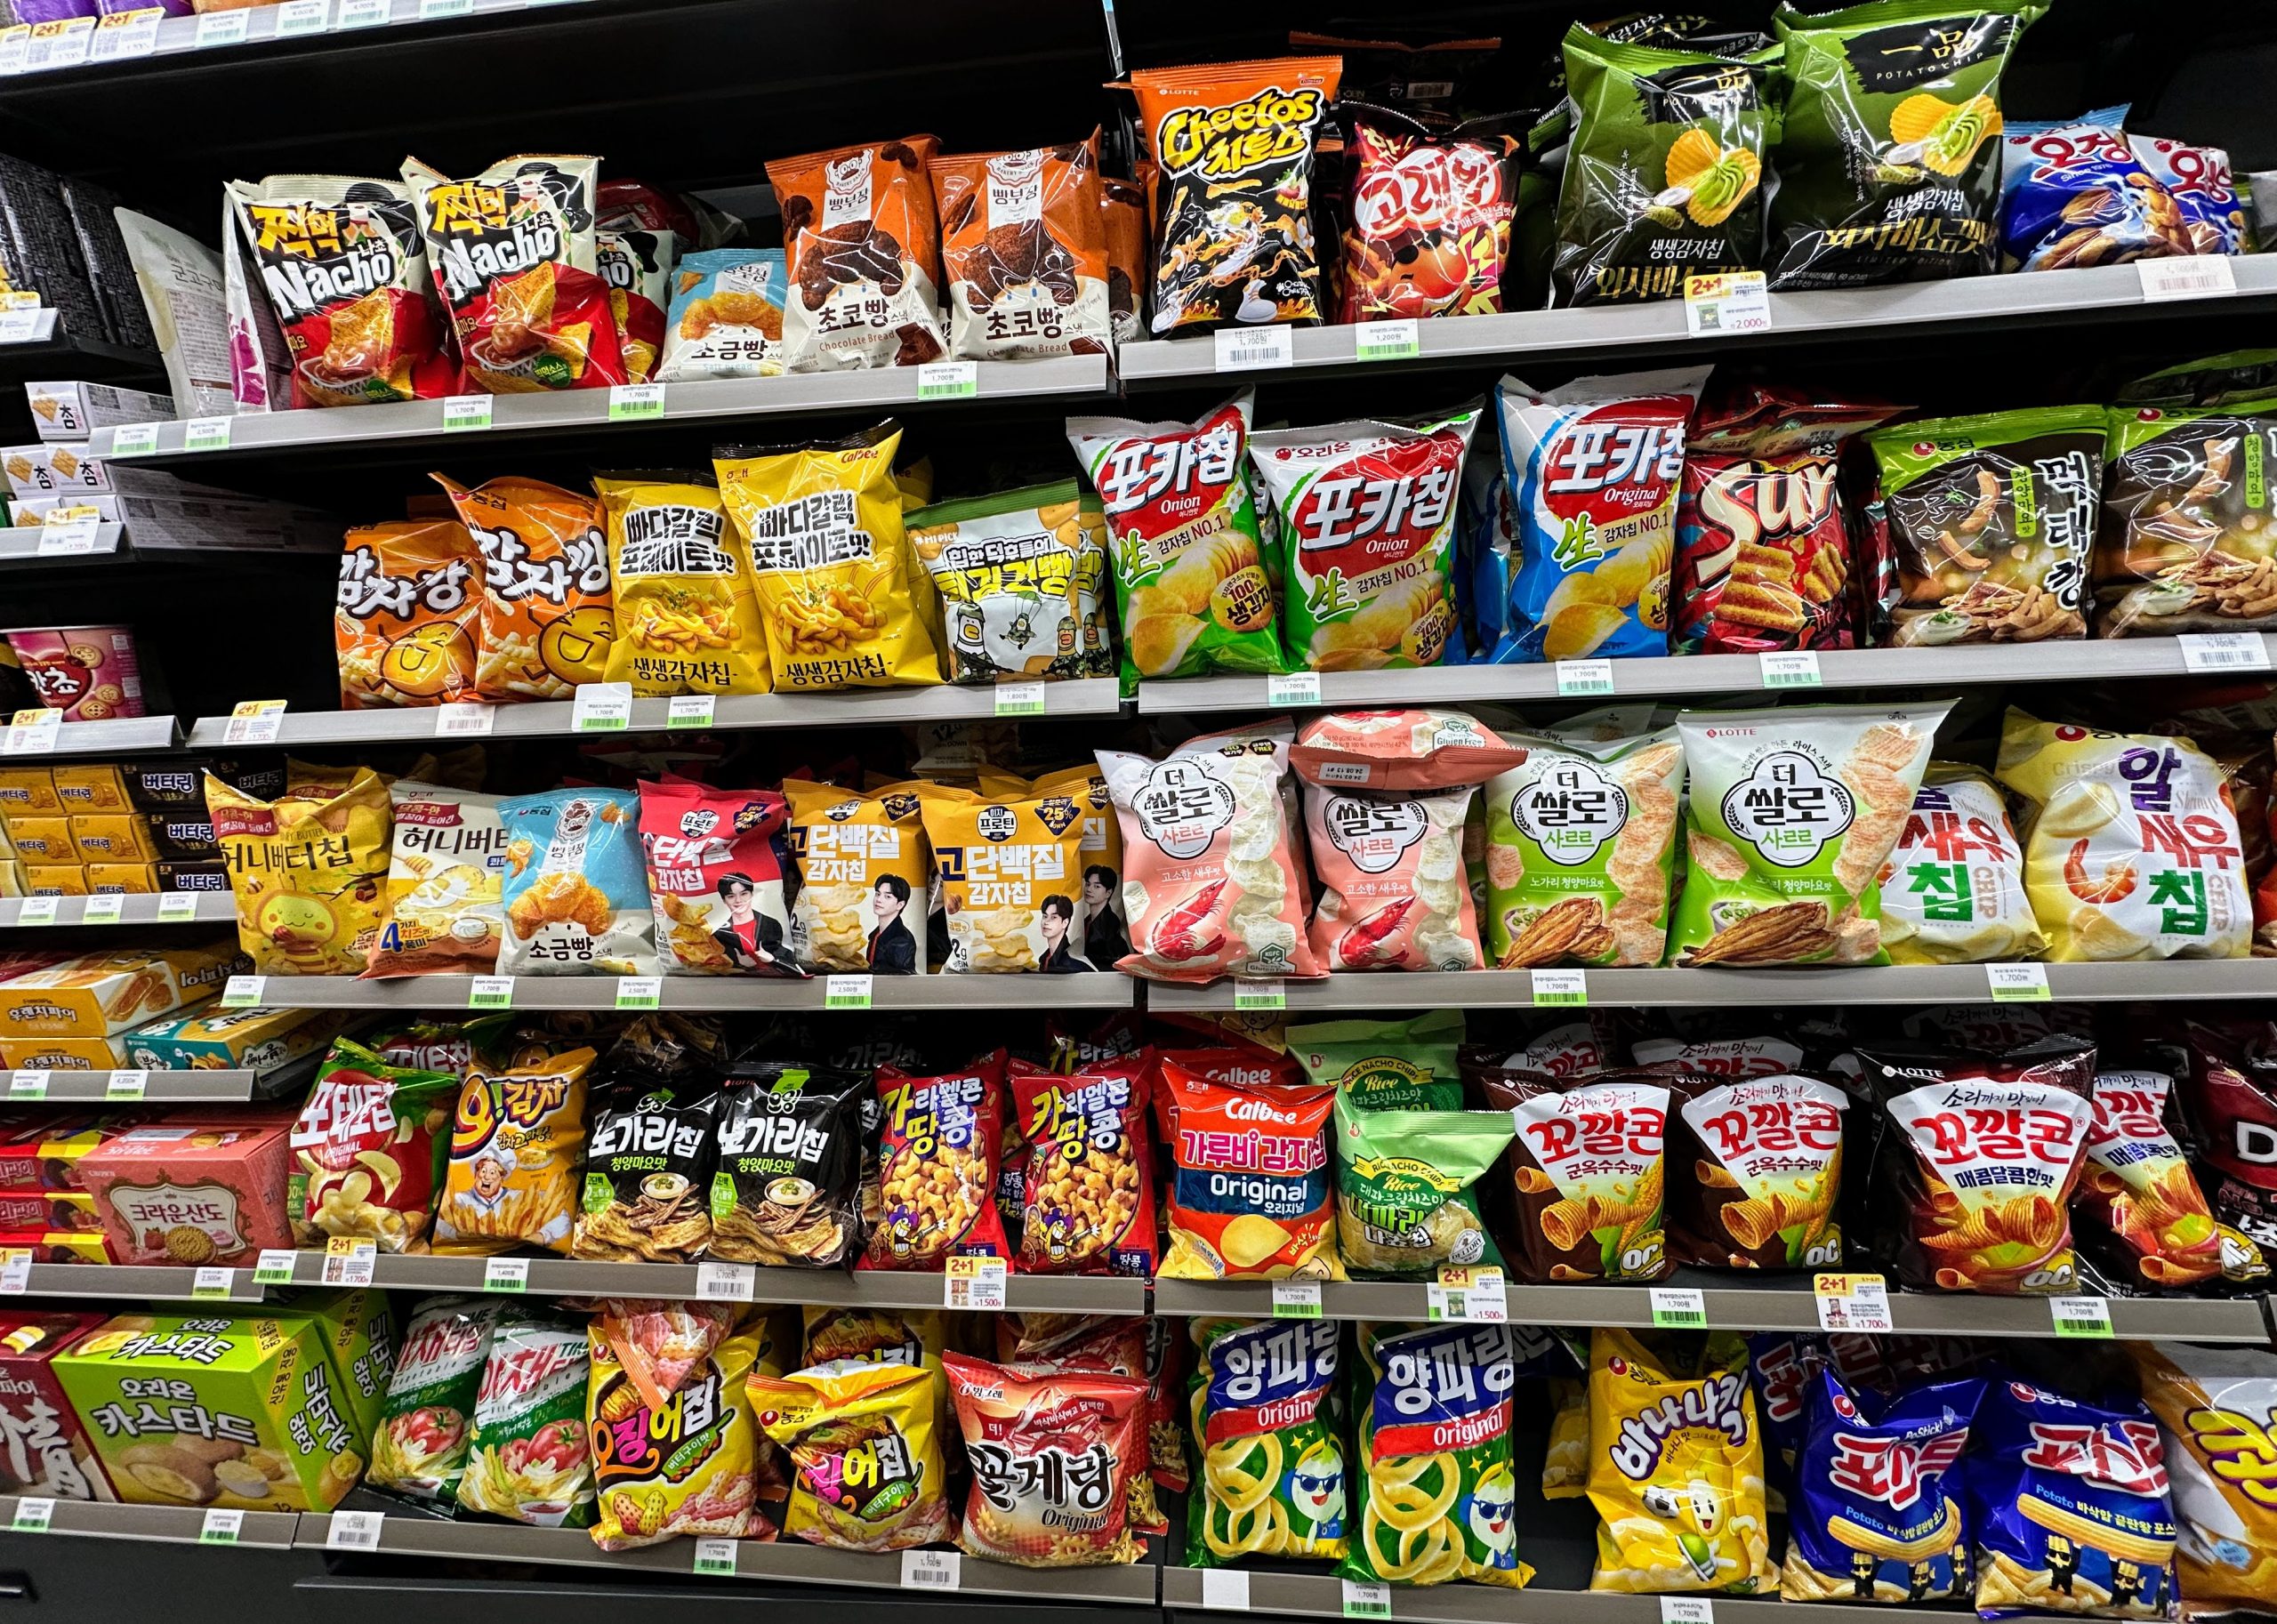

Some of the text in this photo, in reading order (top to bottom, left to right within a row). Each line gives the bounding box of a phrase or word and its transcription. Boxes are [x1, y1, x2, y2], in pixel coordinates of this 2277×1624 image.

[36, 24, 60, 36] 2+1
[104, 13, 129, 27] 2+1
[1169, 88, 1200, 96] LOTTE
[1161, 91, 1316, 168] Cheetos
[1204, 128, 1307, 175] 치토스
[829, 189, 869, 211] 빵부장
[1885, 190, 1965, 218] 생생감자칩
[1648, 238, 1725, 260] 생생감자칩
[447, 226, 555, 303] Nacho
[264, 251, 391, 319] Nacho
[1692, 277, 1722, 295] 2+1
[817, 299, 889, 335] 초코빵
[986, 309, 1063, 341] 초코빵
[691, 340, 768, 360] 소금빵
[819, 329, 895, 352] Chocolate Bread
[1038, 342, 1067, 353] Bread
[841, 447, 879, 465] Calbee
[1296, 441, 1351, 460] 오리온
[1103, 429, 1238, 508] 포카칩
[1160, 494, 1201, 515] Onion
[1604, 486, 1659, 505] Original
[1301, 467, 1455, 550] 포카칩
[935, 532, 958, 543] PICK
[1157, 514, 1226, 555] 감자칩 NO.1
[1604, 512, 1669, 543] 감자칩 NO.1
[1365, 538, 1410, 558] Onion
[1553, 512, 1603, 572] 生
[1118, 529, 1162, 587] 生
[1356, 557, 1428, 593] 감자칩 NO.1
[1307, 568, 1359, 622] 生
[632, 656, 731, 686] 생생감자칩
[785, 653, 889, 686] 생생감자칩
[16, 712, 37, 724] 2+1
[237, 703, 258, 715] 2+1
[1718, 728, 1757, 736] LOTTE
[142, 773, 194, 793] 버터링
[1164, 768, 1185, 786] 더
[1557, 770, 1579, 789] 더
[1772, 762, 1796, 785] 더
[60, 787, 92, 800] 버터링
[1144, 787, 1213, 825] 쌀로
[1530, 790, 1607, 826] 쌀로
[1743, 786, 1830, 826] 쌀로
[980, 816, 1016, 831] 프로틴
[1335, 801, 1407, 837] 쌀로
[81, 838, 110, 850] 버터링
[168, 824, 216, 842] 버터링
[1161, 824, 1208, 845] 사르르
[1543, 827, 1596, 850] 사르르
[1760, 827, 1817, 851] 사르르
[16, 840, 46, 850] 버터링
[1350, 838, 1397, 859] 사르르
[806, 859, 866, 881] 감자칩
[936, 842, 1066, 882] 고단백질
[176, 874, 224, 891] 버터링
[656, 868, 705, 891] 감자칩
[1162, 865, 1221, 883] 고소한 새우맛
[1530, 876, 1605, 890] 노가리 청양마요맛
[1782, 878, 1831, 892] 청양마요맛
[968, 881, 1032, 905] 감자칩
[1347, 881, 1409, 896] 고소한 새우맛
[1906, 862, 1974, 922] 칩
[2146, 867, 2209, 937] 칩
[529, 936, 595, 961] 소금빵
[1364, 1074, 1399, 1092] Rice
[1898, 1067, 1946, 1079] LOTTE
[1941, 1088, 2005, 1108] 소리까지
[1225, 1097, 1297, 1125] Calbee
[1526, 1106, 1666, 1165] 꼬깔콘
[1702, 1101, 1841, 1162] 꼬깔콘
[1910, 1107, 2074, 1165] 꼬깔콘
[1180, 1129, 1260, 1169] 가루비
[610, 1158, 667, 1172] 청양마요맛
[738, 1158, 795, 1174] 청양마요맛
[1565, 1158, 1644, 1180] 군옥수수맛
[1744, 1154, 1823, 1178] 군옥수수맛
[1953, 1165, 2056, 1189] 매콤달콤한맛
[1211, 1174, 1307, 1205] Original
[129, 1202, 227, 1225] 크라운산도
[1264, 1202, 1305, 1215] 오리지널
[331, 1238, 350, 1250] 2+1
[950, 1258, 975, 1274] 2+1
[1443, 1268, 1469, 1282] 2+1
[1819, 1276, 1847, 1291] 2+1
[119, 1377, 197, 1402] 오리온
[91, 1403, 261, 1446] 카스타드
[1433, 1409, 1504, 1447] Original
[1610, 1369, 1749, 1481] 바나나킥
[667, 1431, 713, 1473] 버터구이맛
[2036, 1484, 2074, 1509] Potato
[1042, 1508, 1107, 1533] Original
[1845, 1505, 1885, 1532] Potato
